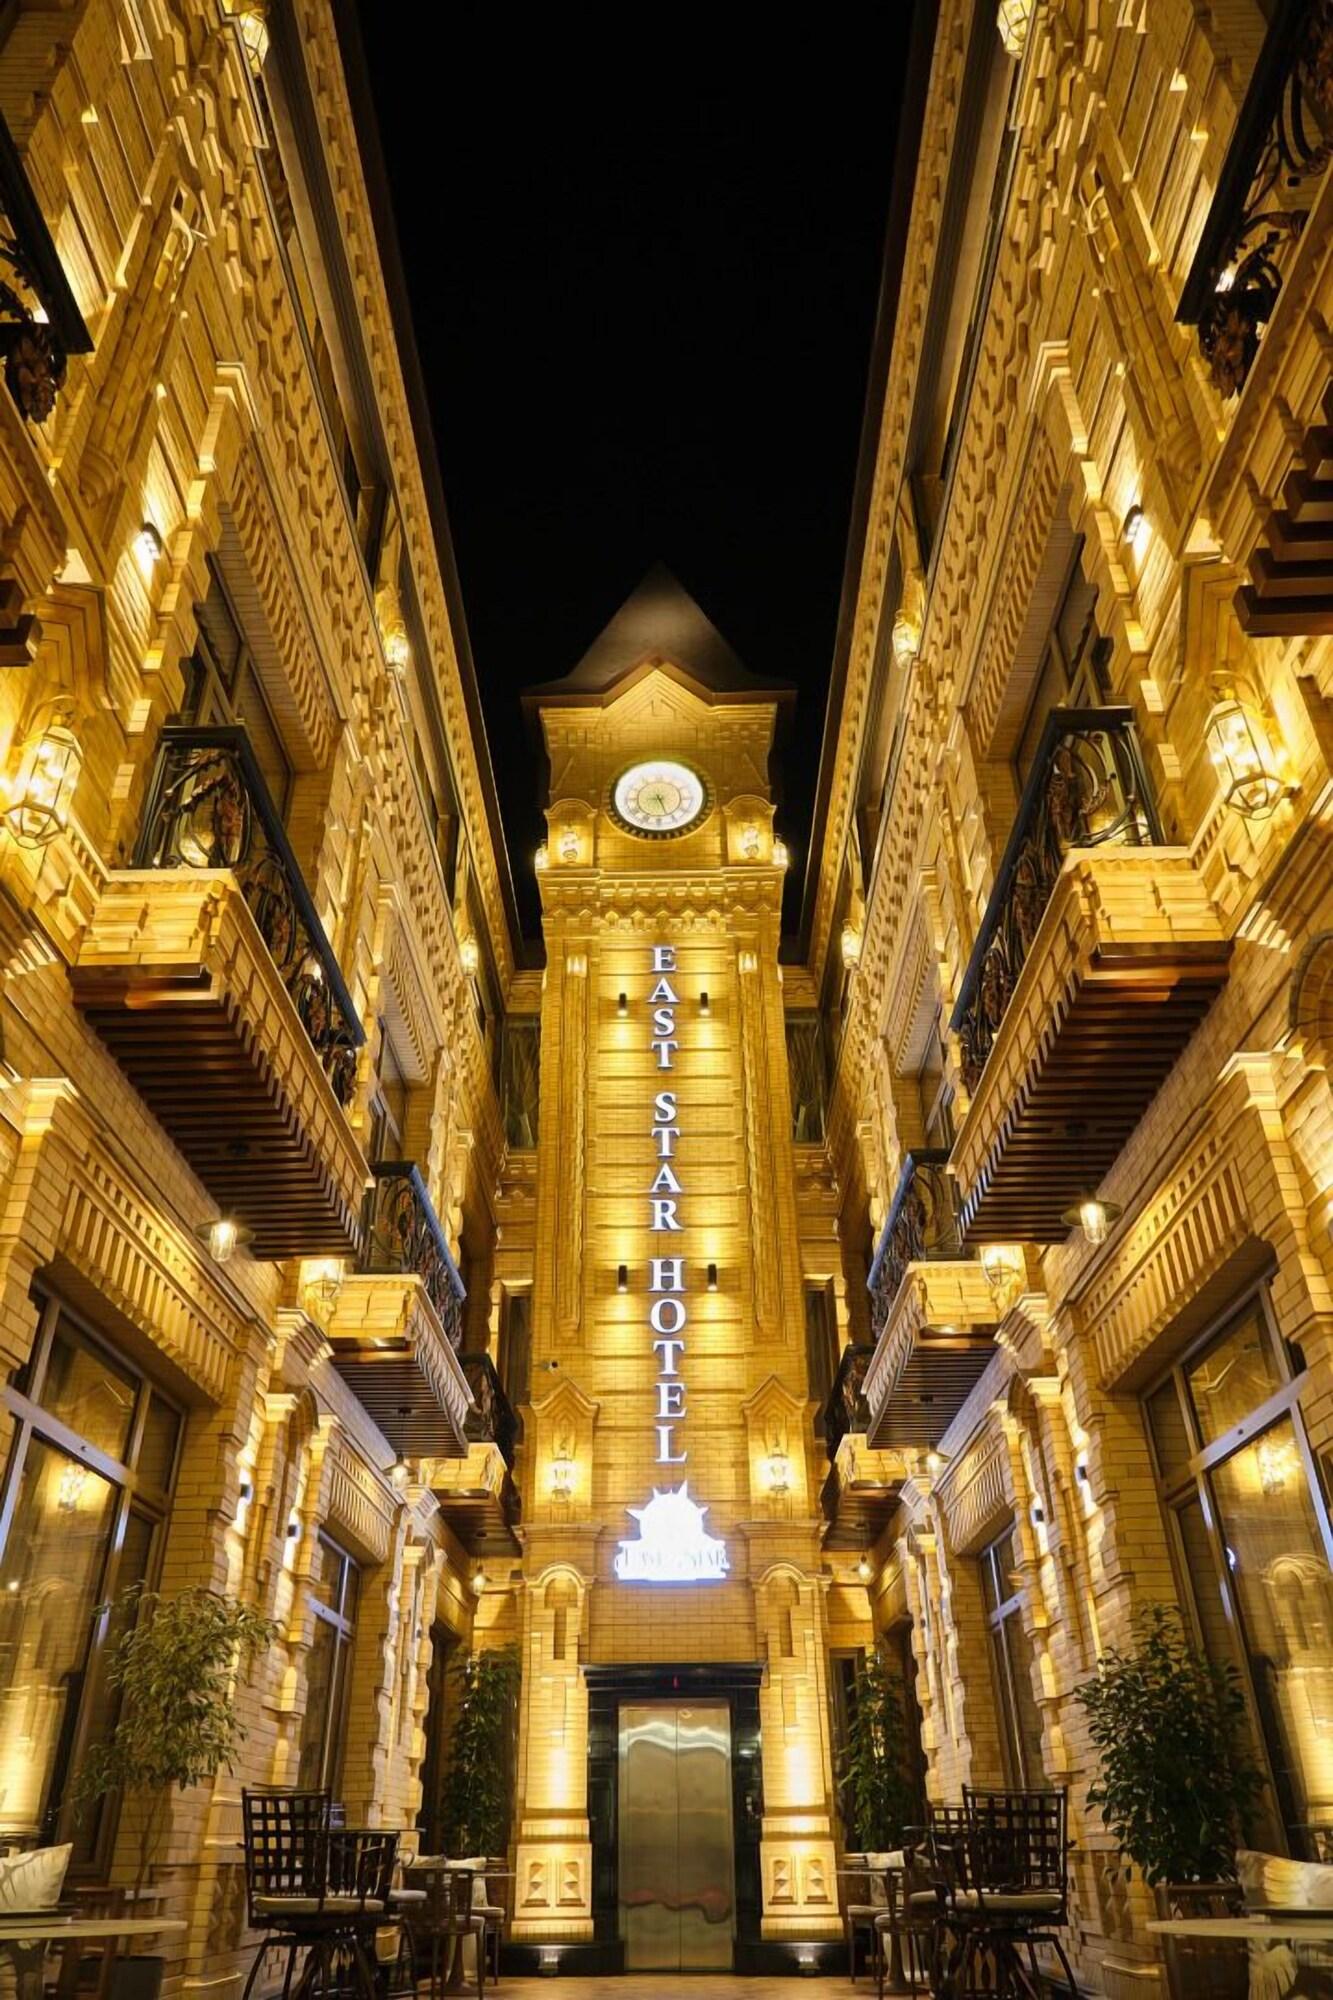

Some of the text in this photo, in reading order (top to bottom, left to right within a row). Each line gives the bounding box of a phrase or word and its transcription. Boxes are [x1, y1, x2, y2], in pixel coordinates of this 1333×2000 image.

[648, 946, 687, 1463] EAST STAR HOTEL
